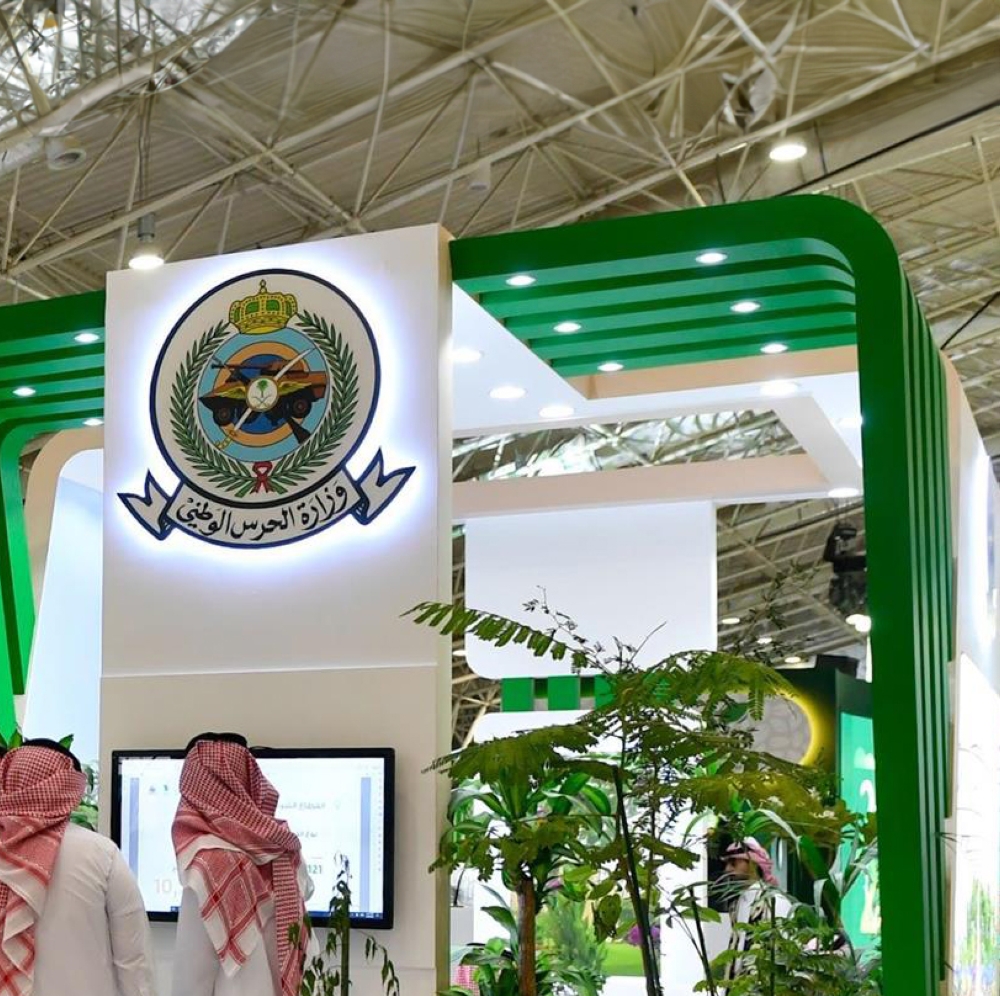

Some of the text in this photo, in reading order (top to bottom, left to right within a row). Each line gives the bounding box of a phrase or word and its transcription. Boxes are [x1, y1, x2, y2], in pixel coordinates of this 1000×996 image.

[176, 480, 348, 541] وزارة الحرس الوطني
